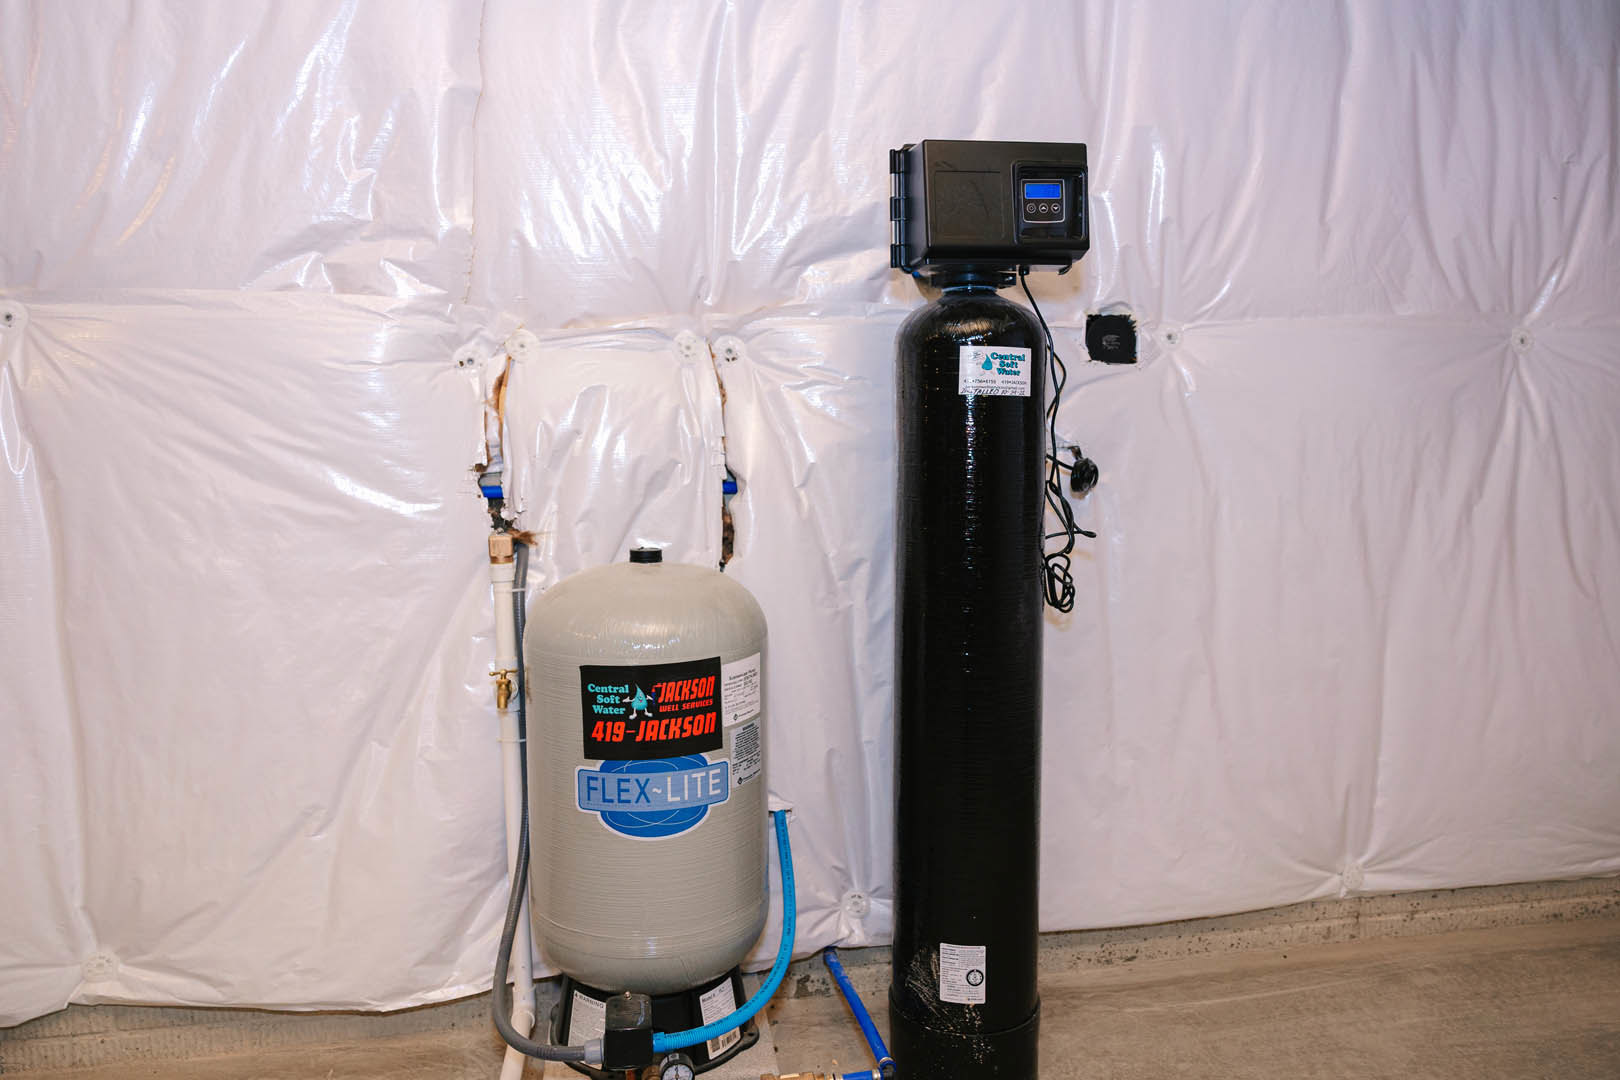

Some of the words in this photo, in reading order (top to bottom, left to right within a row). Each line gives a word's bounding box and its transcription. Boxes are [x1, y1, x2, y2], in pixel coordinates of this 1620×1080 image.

[990, 352, 1025, 361] Central
[999, 360, 1018, 368] Soft
[996, 367, 1020, 376] Water
[587, 683, 630, 694] Central
[656, 675, 716, 704] JACKSON
[596, 694, 621, 704] Soft
[592, 704, 626, 715] Water
[659, 703, 680, 713] WELL
[682, 699, 714, 711] SERVICES
[591, 711, 717, 743] 419-JACKSON
